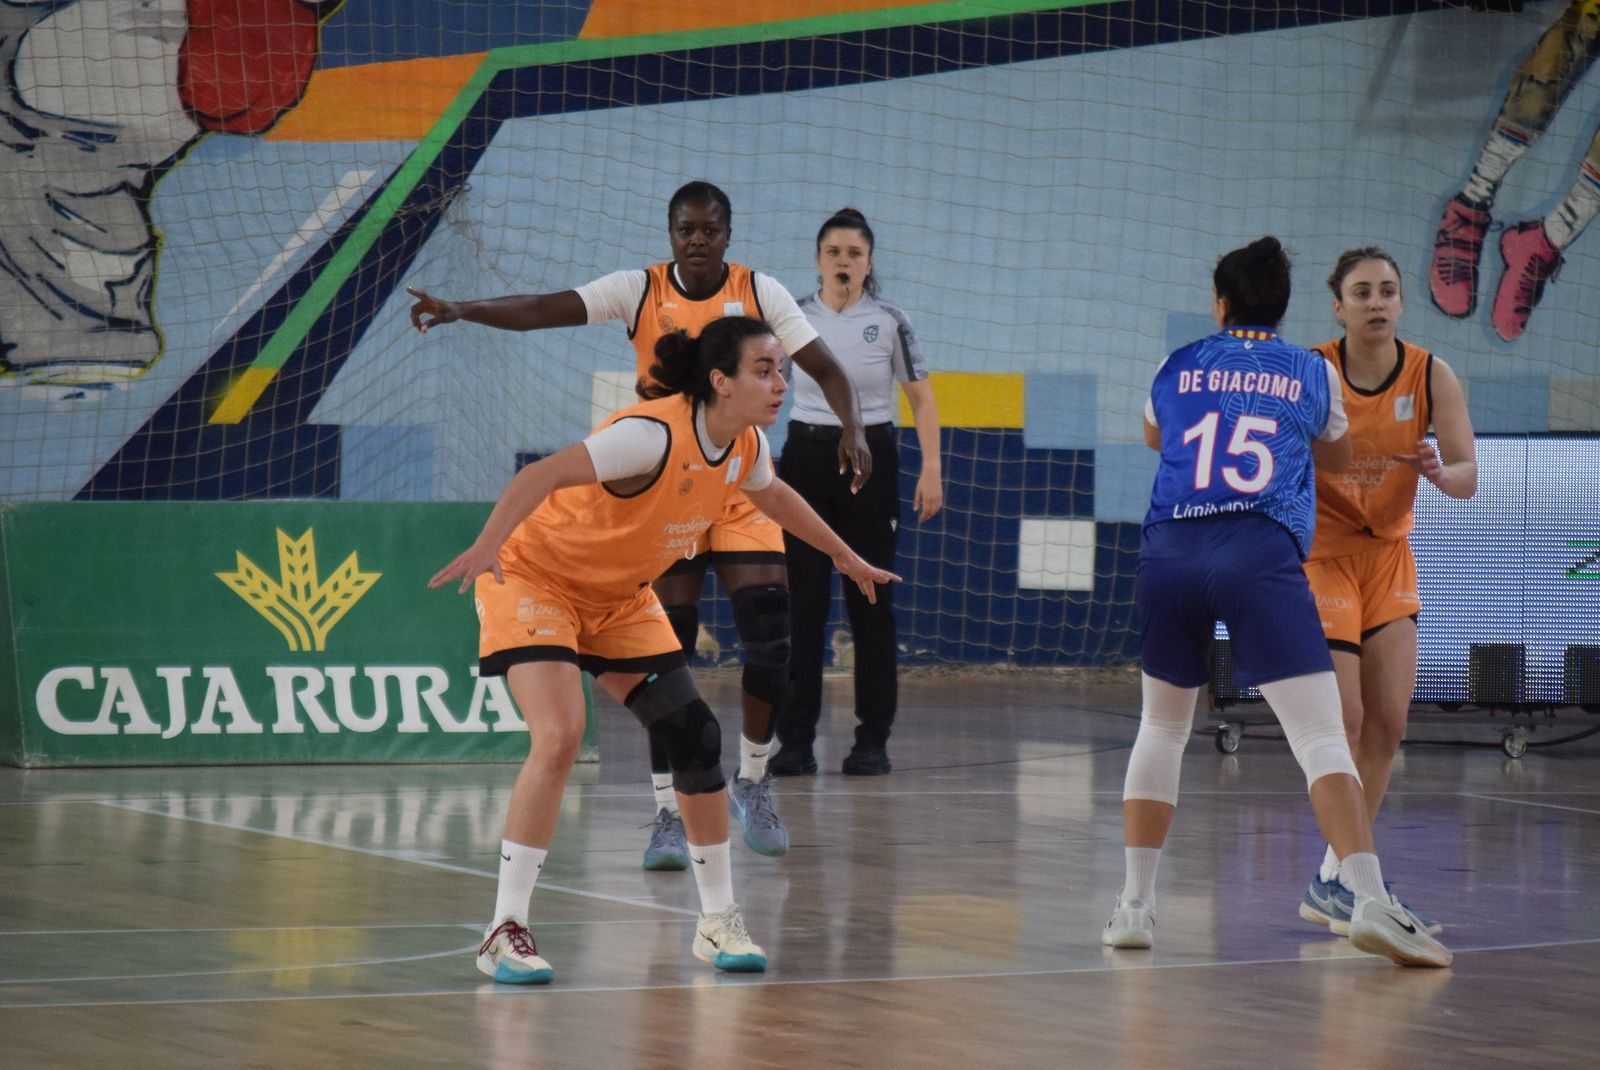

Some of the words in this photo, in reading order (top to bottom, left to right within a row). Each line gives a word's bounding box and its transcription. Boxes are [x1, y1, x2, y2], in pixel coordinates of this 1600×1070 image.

[1178, 369, 1204, 393] DE
[1207, 369, 1302, 403] GIACOMO
[1182, 411, 1278, 494] 15
[35, 666, 264, 740] CAJA
[266, 665, 530, 734] RURA
